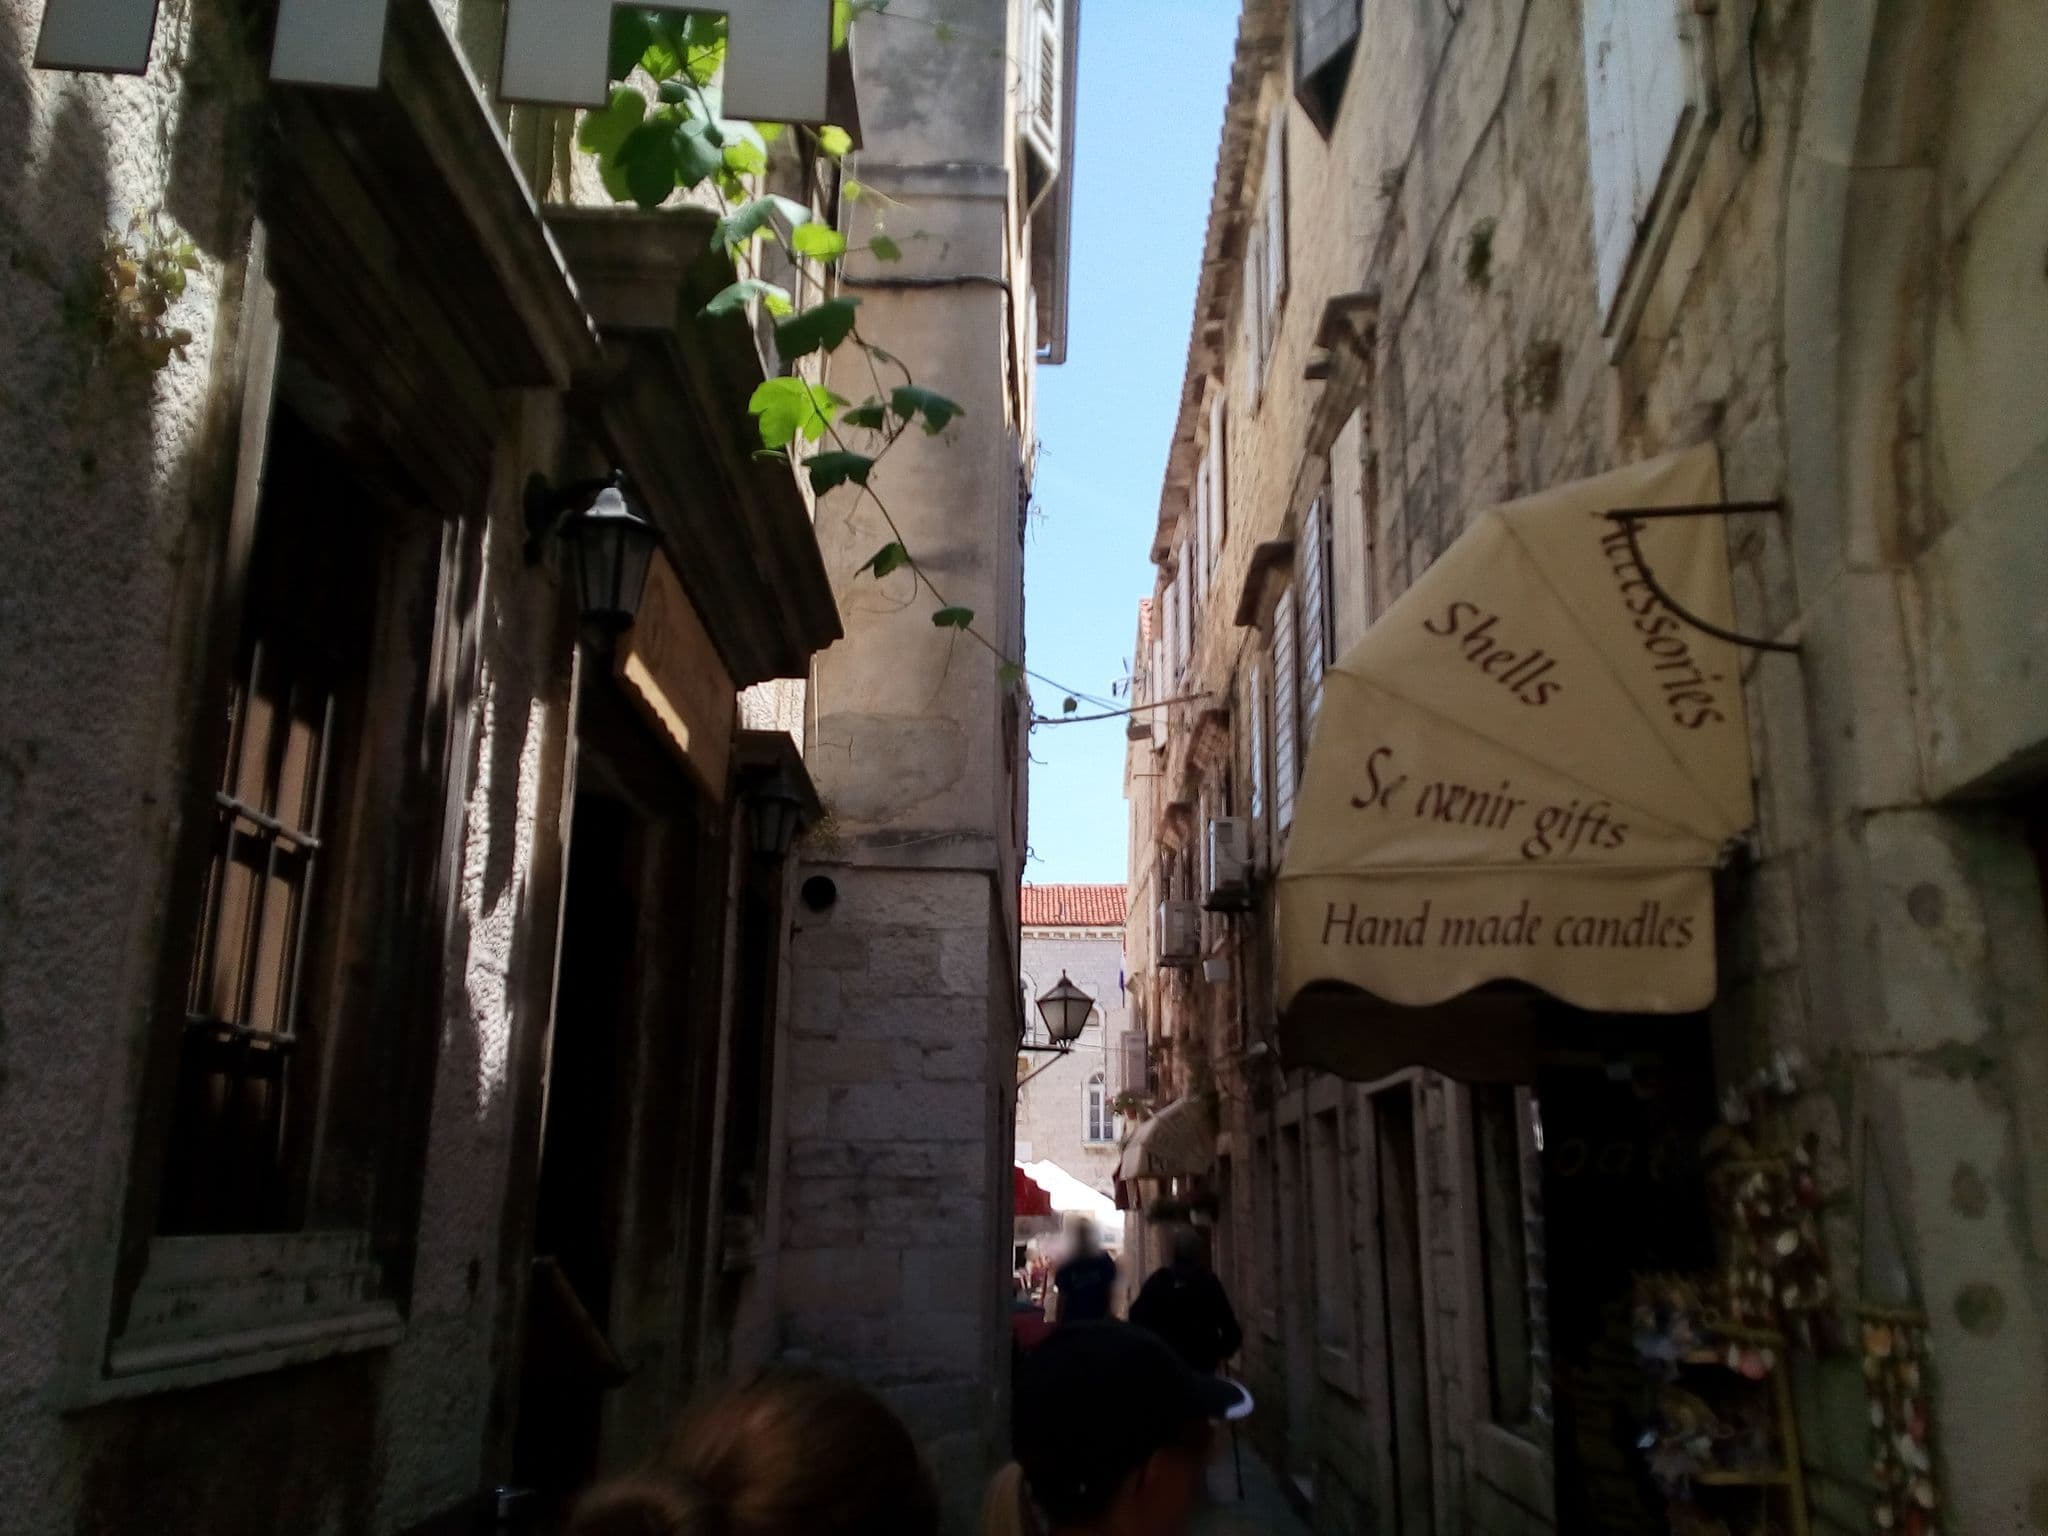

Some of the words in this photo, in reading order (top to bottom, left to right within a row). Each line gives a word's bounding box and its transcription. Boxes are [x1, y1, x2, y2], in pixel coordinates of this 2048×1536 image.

[1424, 601, 1562, 708] Shells
[1521, 798, 1629, 860] gifts
[1321, 901, 1432, 949] Hand
[1439, 899, 1542, 949] made
[1554, 900, 1694, 950] candles
